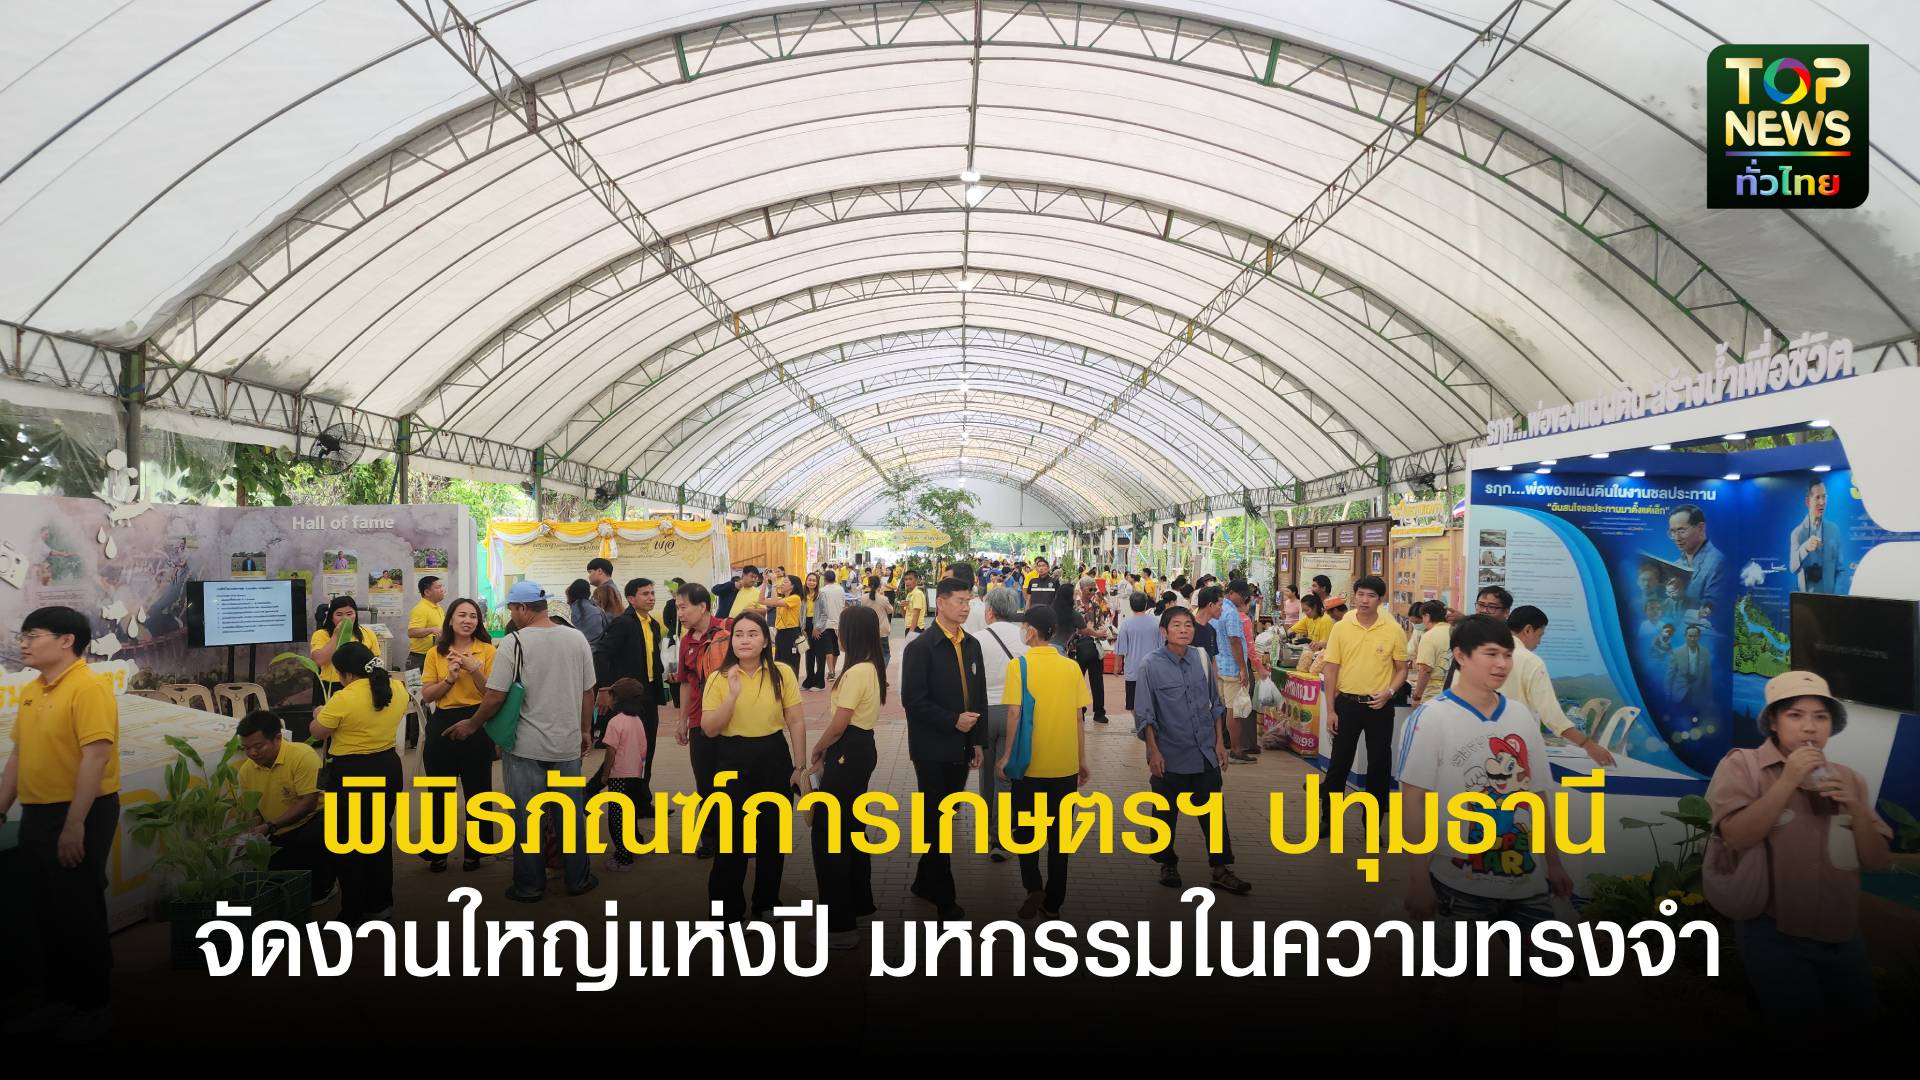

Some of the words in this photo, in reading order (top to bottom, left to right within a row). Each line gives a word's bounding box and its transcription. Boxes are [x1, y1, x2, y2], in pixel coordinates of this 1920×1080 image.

[291, 514, 326, 531] Hall
[329, 514, 349, 531] of
[352, 514, 395, 531] fame
